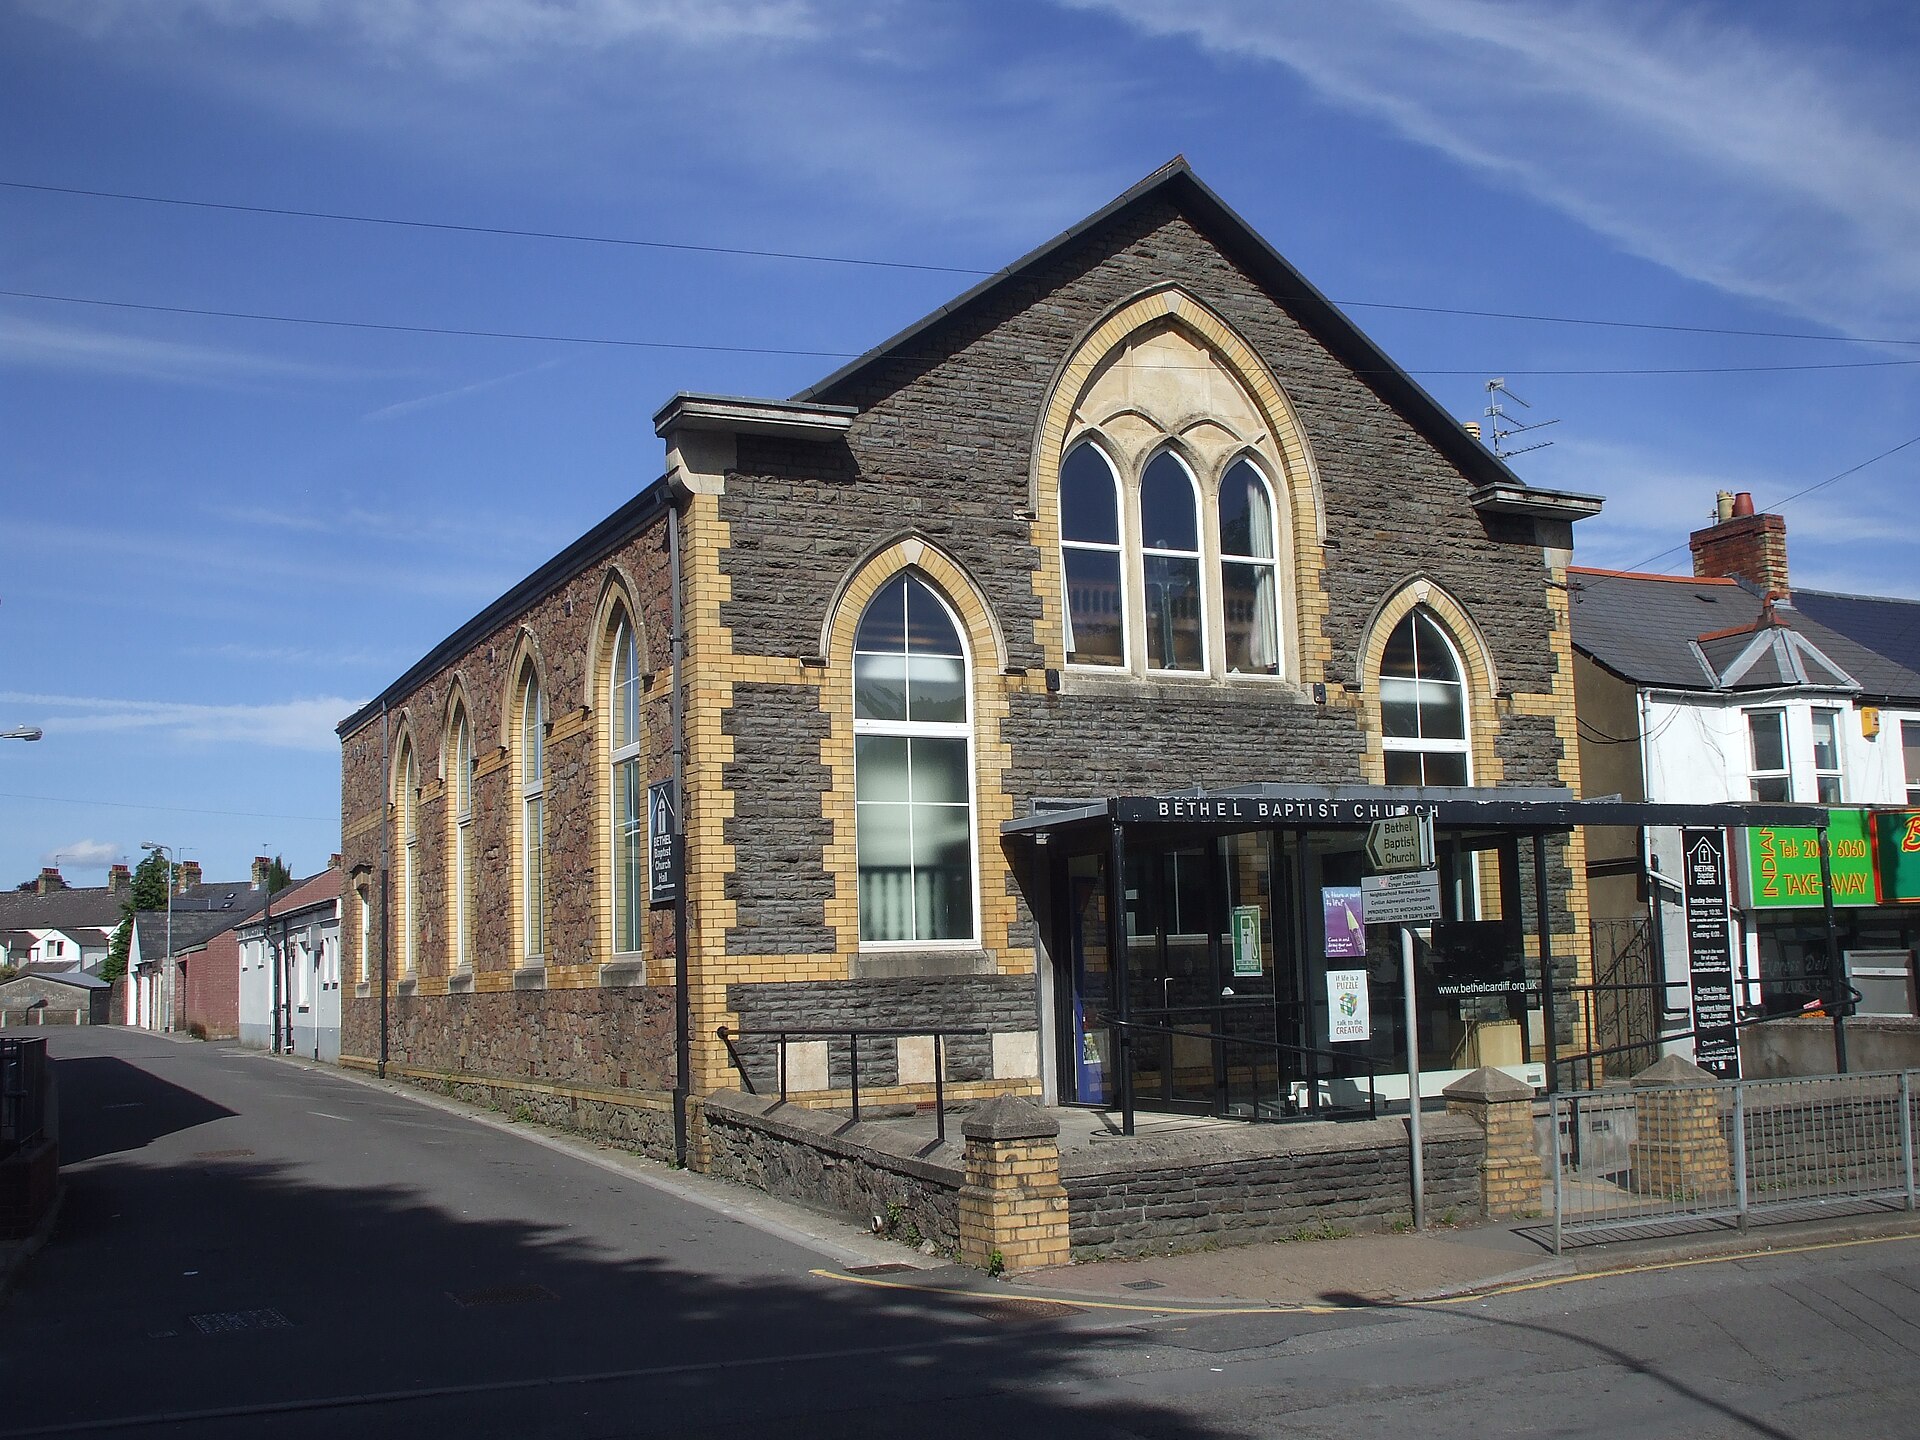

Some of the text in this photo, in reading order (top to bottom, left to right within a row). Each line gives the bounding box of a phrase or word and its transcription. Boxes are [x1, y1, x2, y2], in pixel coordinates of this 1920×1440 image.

[1159, 802, 1242, 817] BETHEL
[1258, 803, 1339, 817] BAPTIST
[1384, 820, 1412, 834] Bethel
[654, 834, 672, 847] BETHEL
[1384, 836, 1415, 850] Baptist
[655, 847, 671, 860] Baptist
[1779, 838, 1798, 858] Tel:
[1837, 840, 1866, 858] 6060
[1386, 852, 1415, 863] Church
[655, 859, 671, 870] Church
[659, 872, 668, 882] Hall
[1438, 981, 1537, 994] www.bethelcardiff.org.uk
[1336, 1026, 1363, 1034] CREATOR
